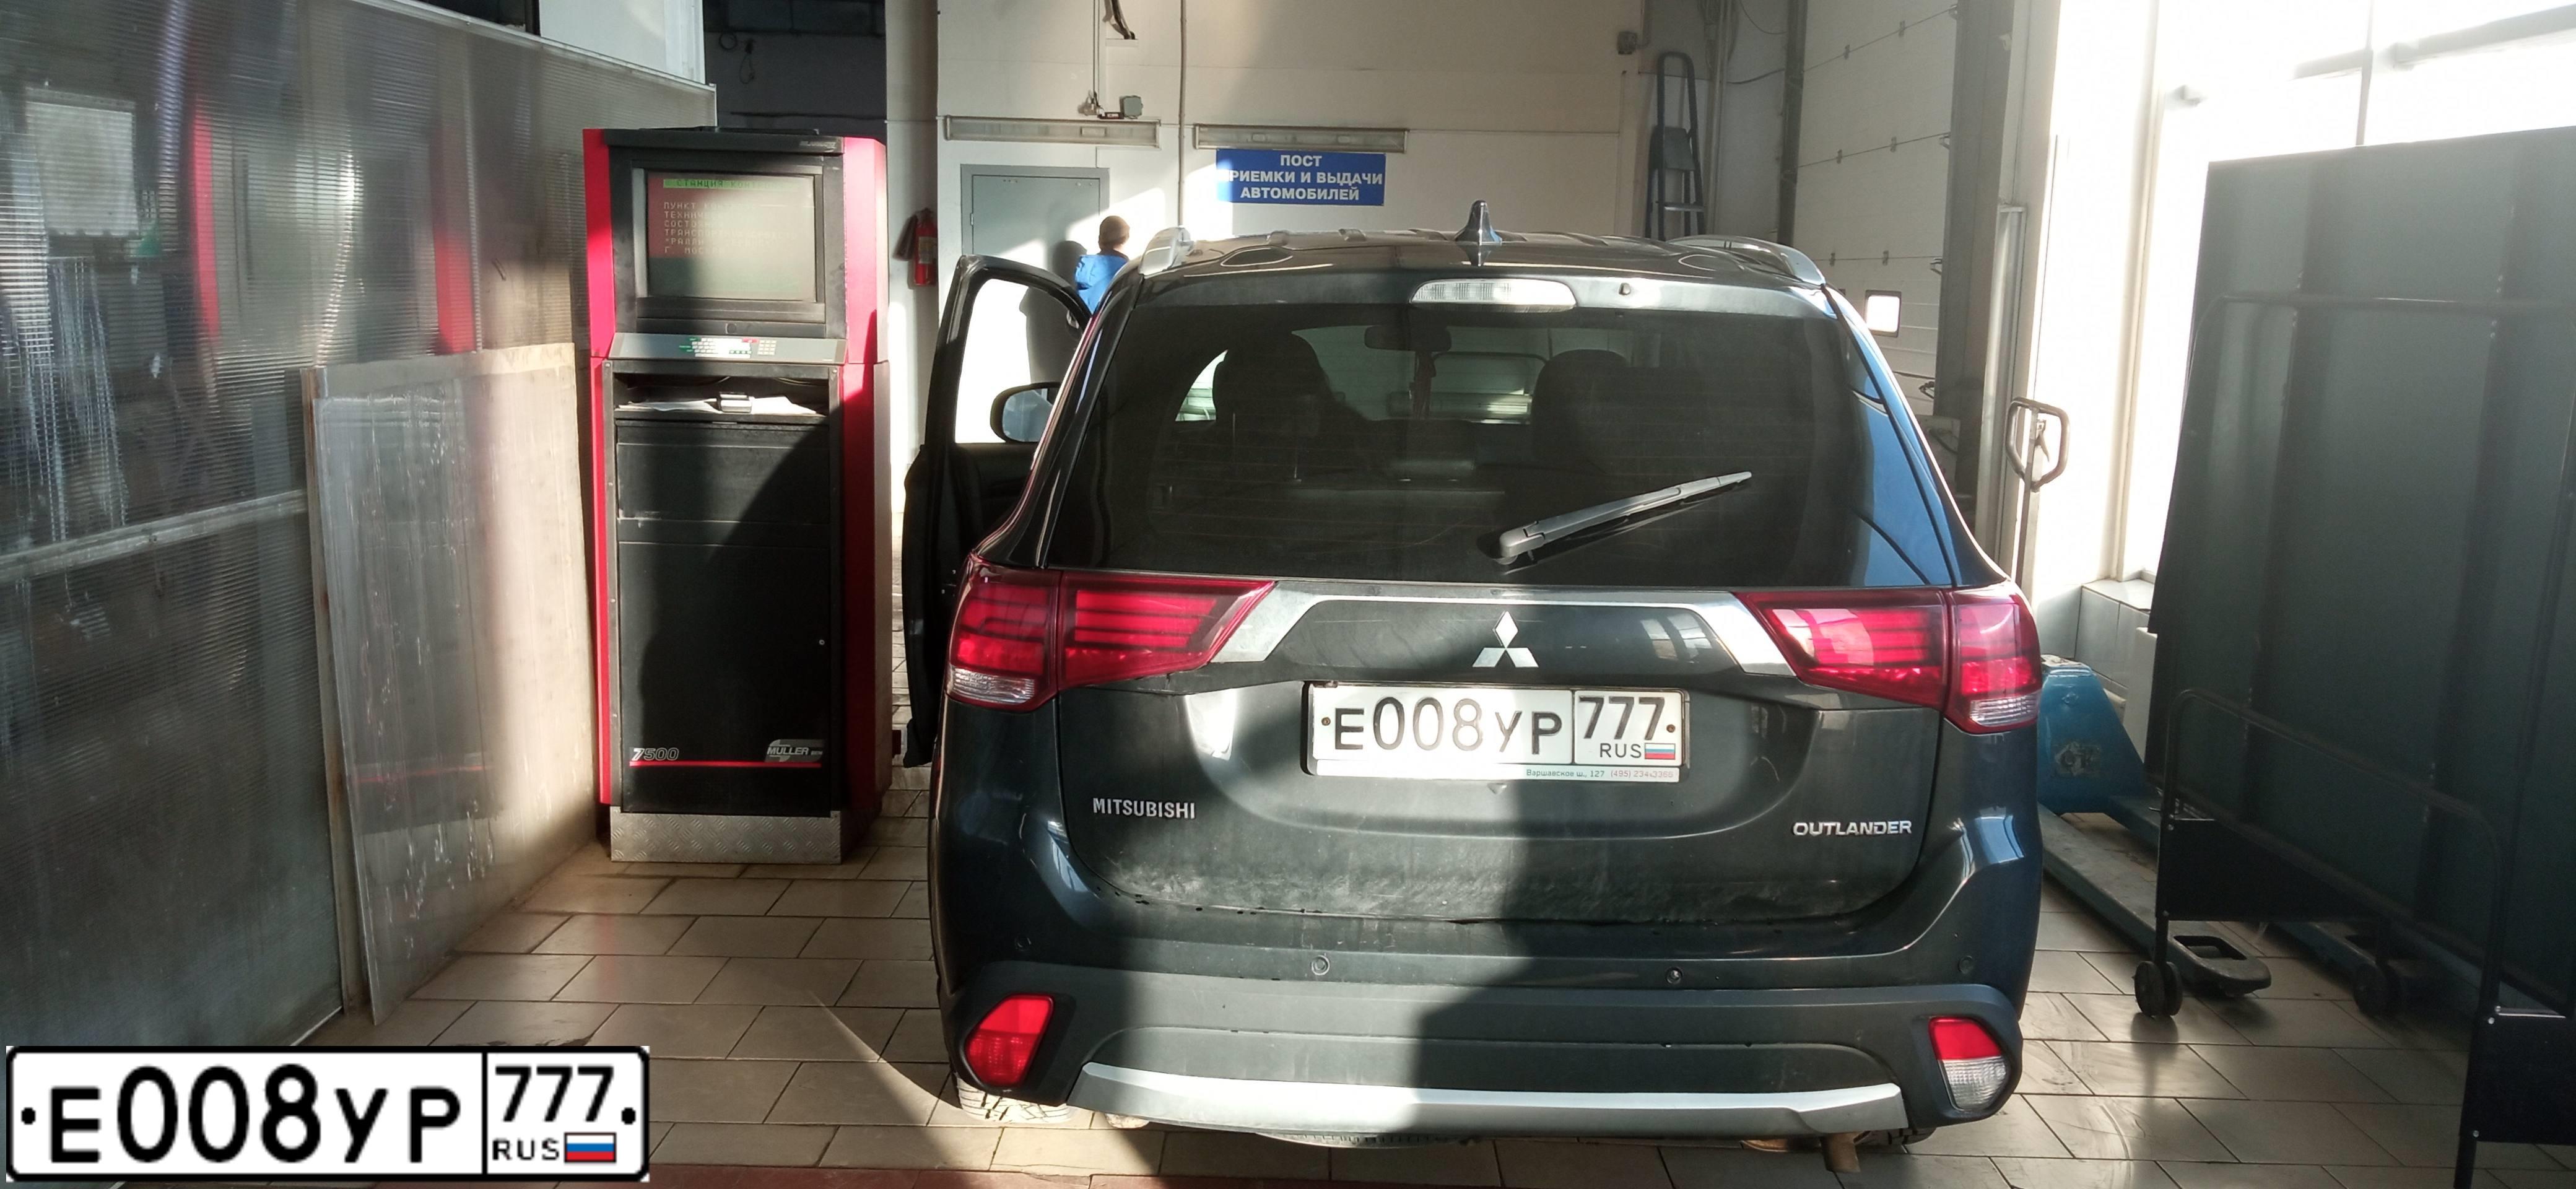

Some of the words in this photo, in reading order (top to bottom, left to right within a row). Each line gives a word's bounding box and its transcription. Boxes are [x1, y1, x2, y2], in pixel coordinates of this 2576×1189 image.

[1280, 155, 1322, 167] ПОСТ
[1219, 170, 1295, 183] РИЕМКИ
[1301, 172, 1311, 183] И
[1316, 172, 1383, 186] ВЫДАЧИ
[1240, 186, 1359, 200] АВТОМОБИЛЕЙ
[1335, 696, 1562, 754] Е008УР
[1579, 696, 1664, 740] 777
[632, 747, 679, 761] 7500
[767, 747, 809, 755] MULLER
[1600, 743, 1642, 758] RUS
[1526, 769, 1574, 777] Варшавское
[1611, 770, 1631, 778] (495)
[1093, 798, 1195, 819] MITSUBISHI
[1793, 821, 1912, 835] OUTLANDER
